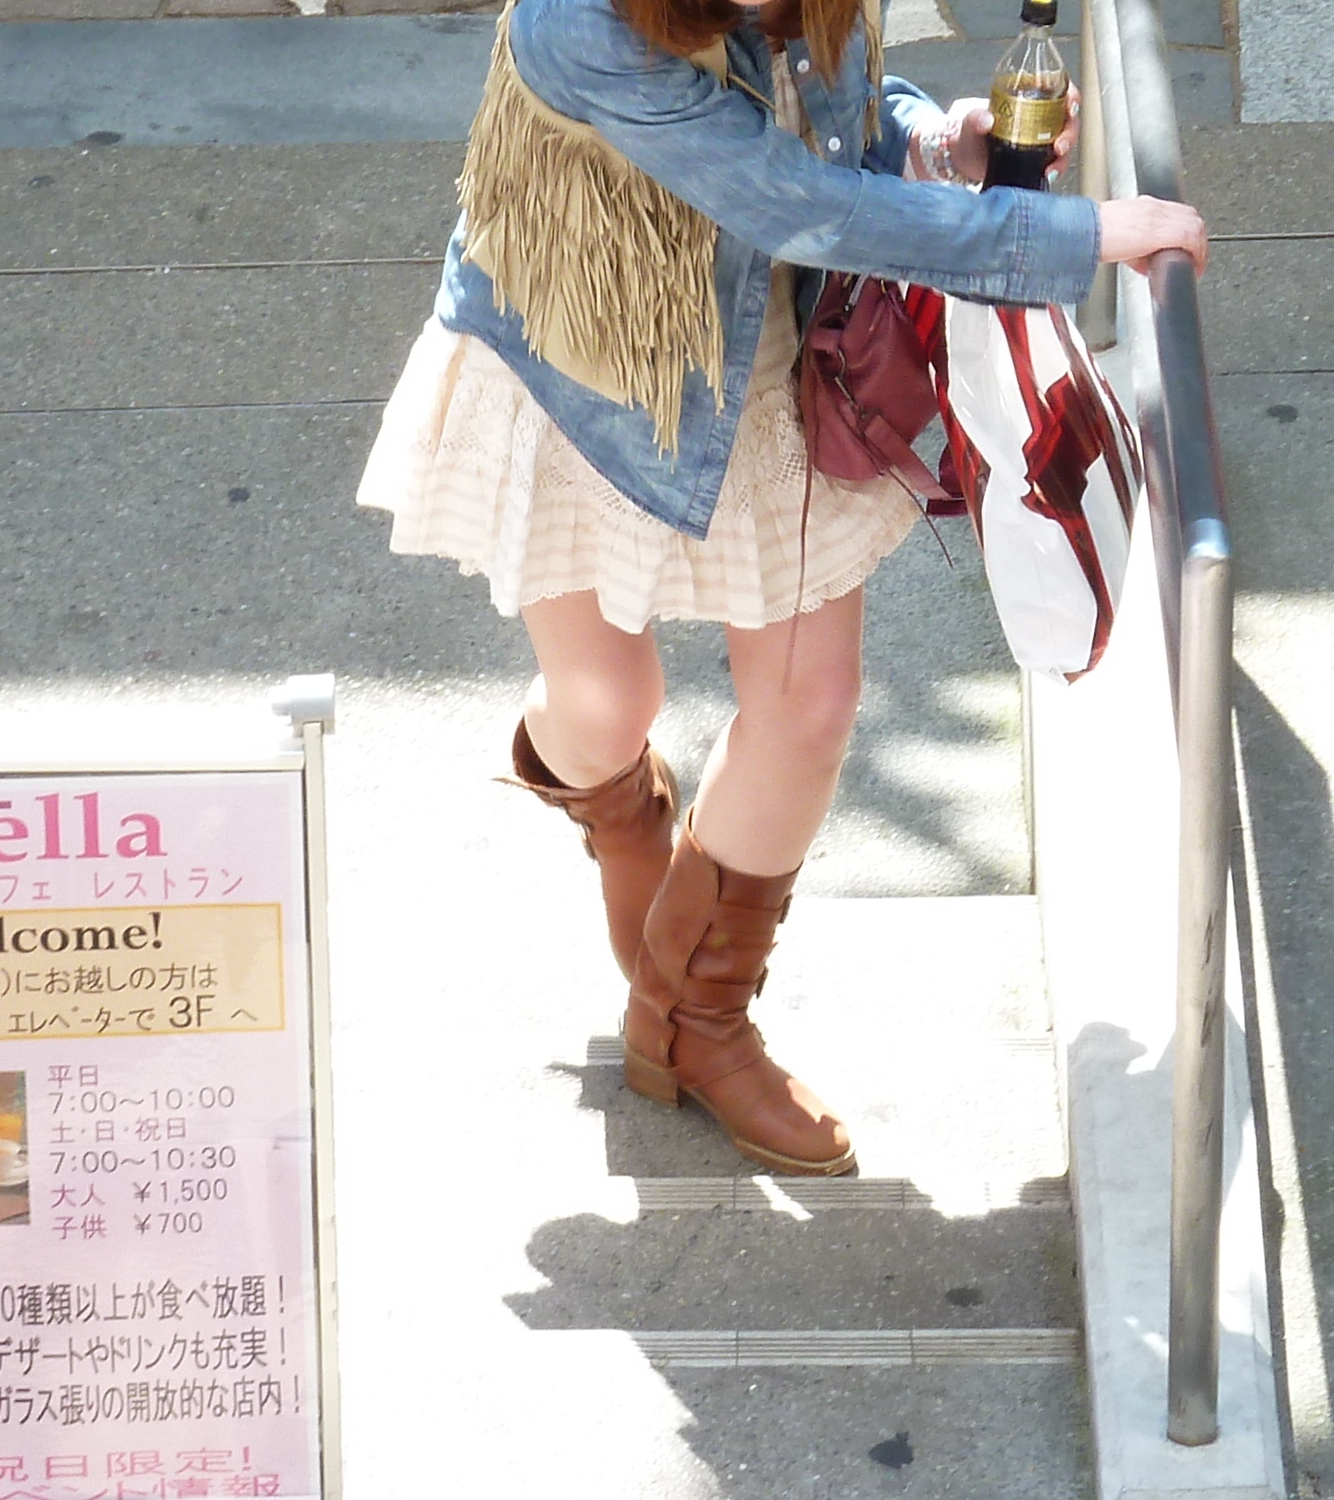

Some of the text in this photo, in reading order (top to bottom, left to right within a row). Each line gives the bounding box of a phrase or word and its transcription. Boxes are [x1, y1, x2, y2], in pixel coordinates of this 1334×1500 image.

[93, 866, 244, 900] レストラン
[168, 994, 217, 1030] 3F
[47, 1064, 99, 1089] 平日
[51, 1182, 105, 1209] 大人
[51, 1213, 108, 1240] 子供
